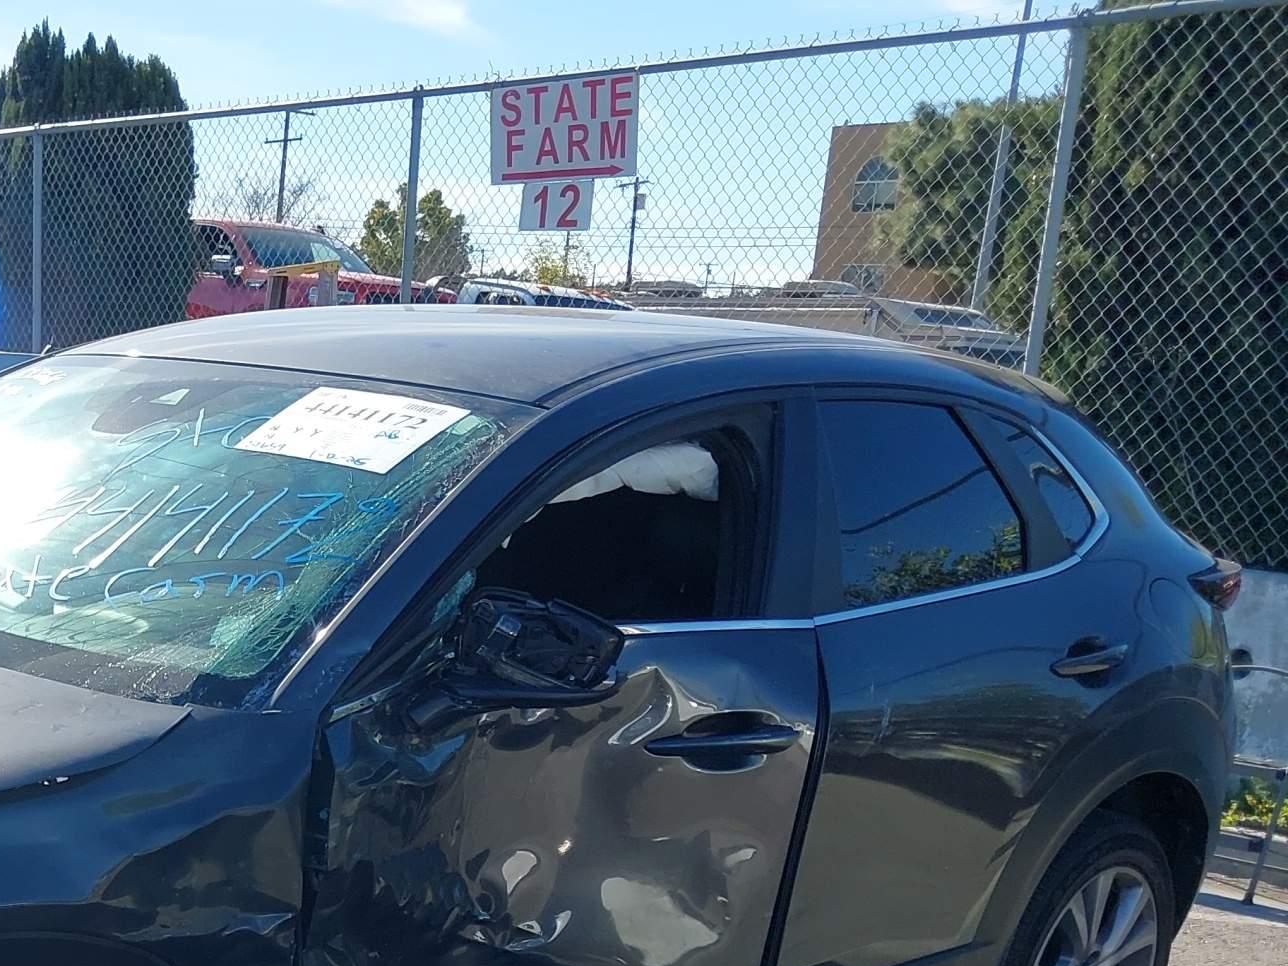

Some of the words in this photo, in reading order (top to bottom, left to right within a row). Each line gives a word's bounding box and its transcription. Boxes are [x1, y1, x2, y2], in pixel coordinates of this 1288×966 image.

[501, 76, 633, 127] STATE
[507, 120, 626, 167] FARM
[534, 184, 581, 228] 12
[305, 402, 428, 430] 44141172
